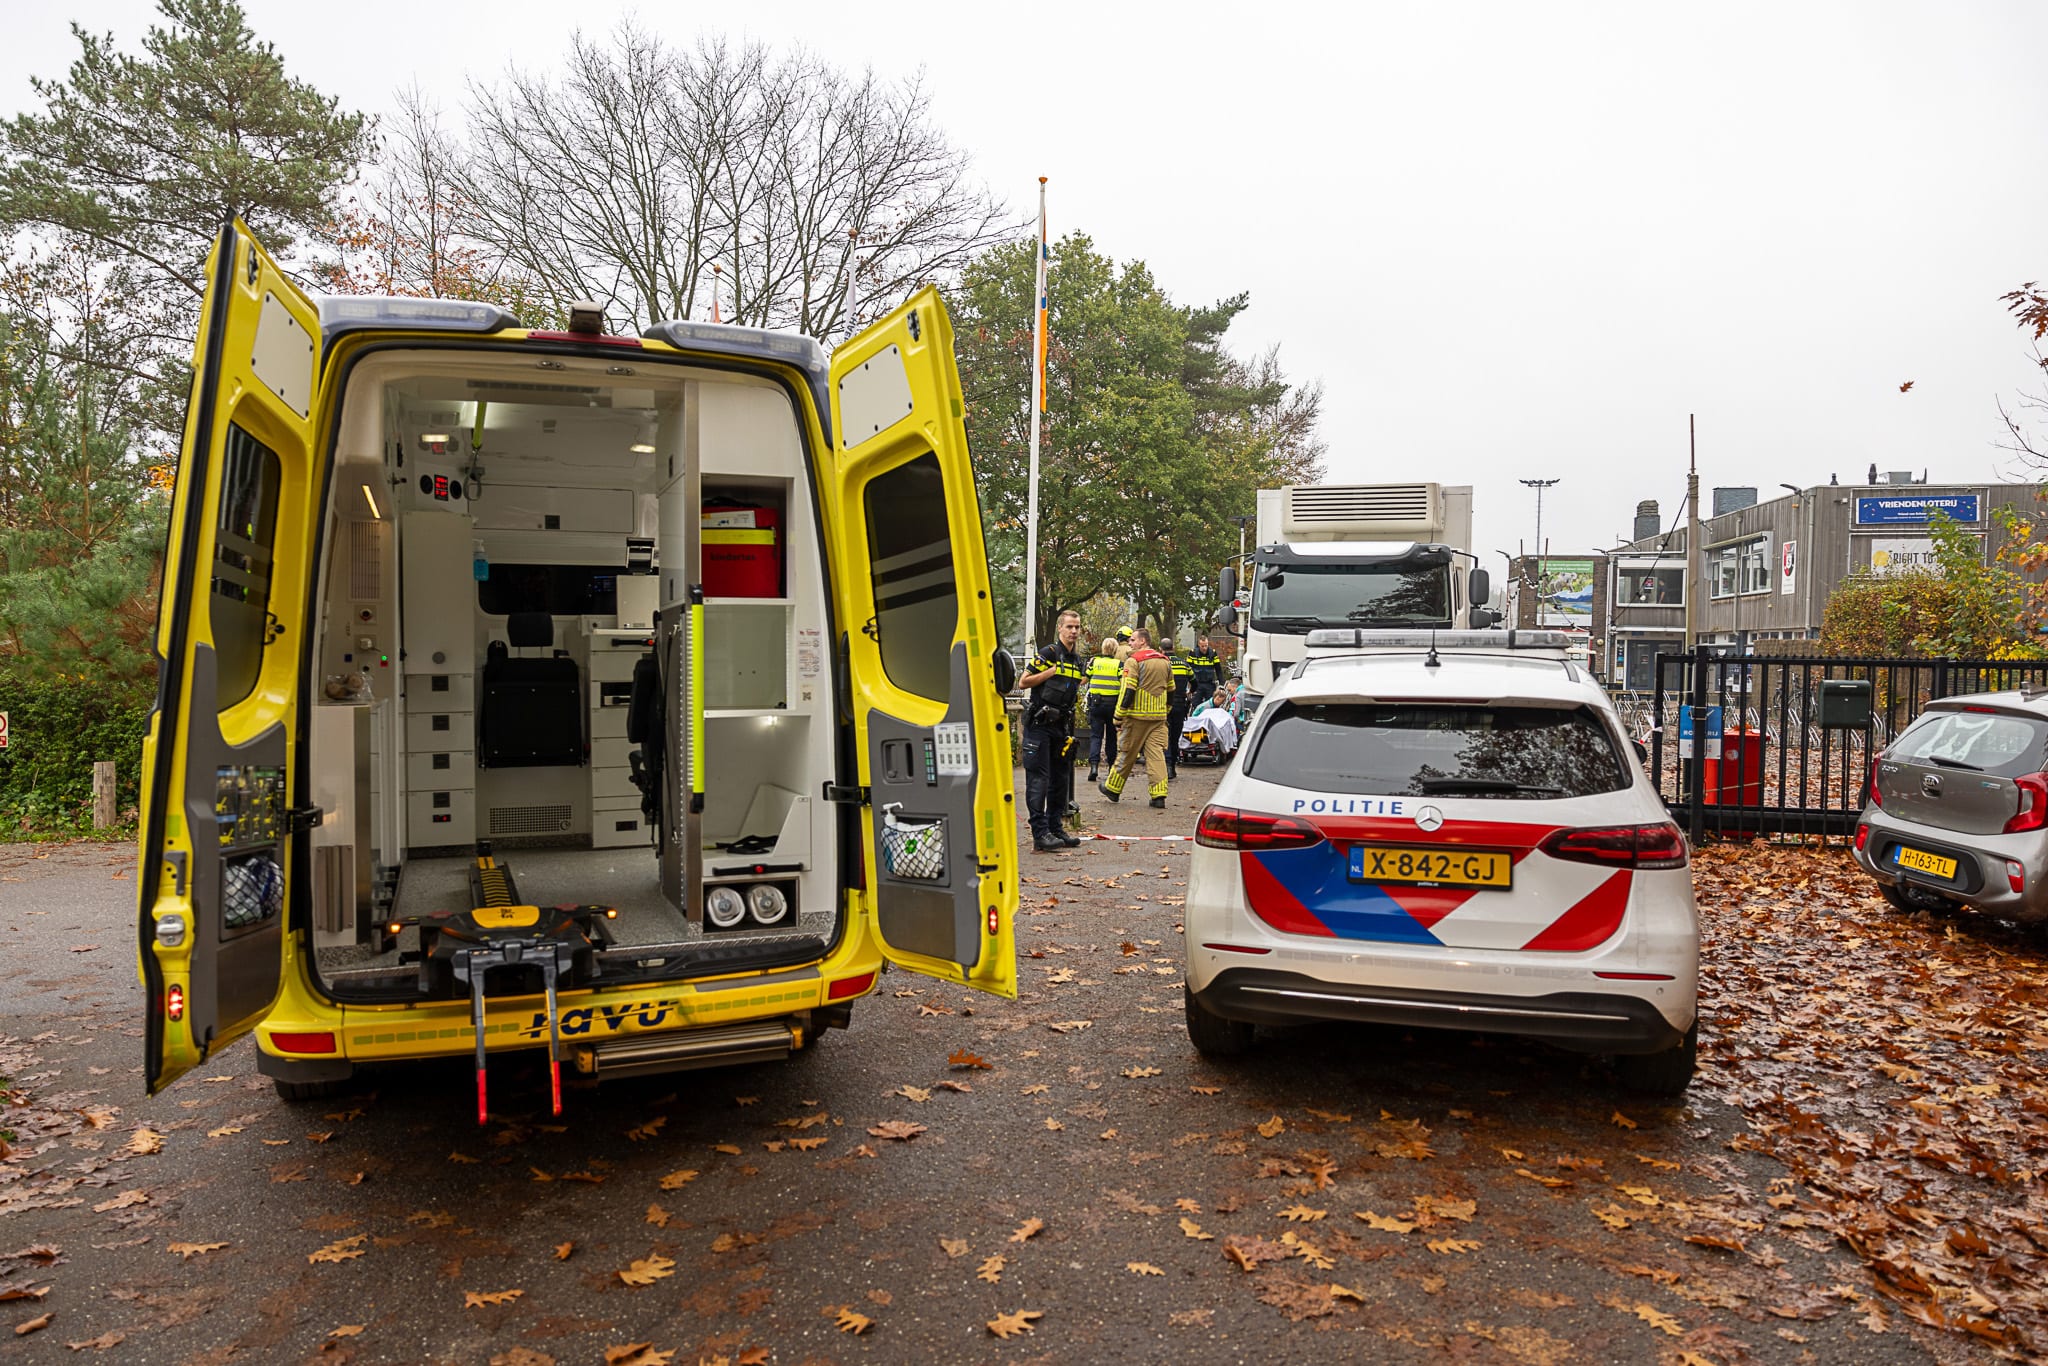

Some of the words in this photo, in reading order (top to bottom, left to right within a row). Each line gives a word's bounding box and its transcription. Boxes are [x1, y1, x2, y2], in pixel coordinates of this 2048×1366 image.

[1878, 499, 1957, 508] VRIENDENLOTERIJ
[1893, 552, 1918, 564] RIGHT
[1293, 799, 1403, 815] POLITIE
[1351, 865, 1362, 873] NL
[1370, 852, 1495, 881] X-842-GJ
[1904, 850, 1948, 874] H-163-TL
